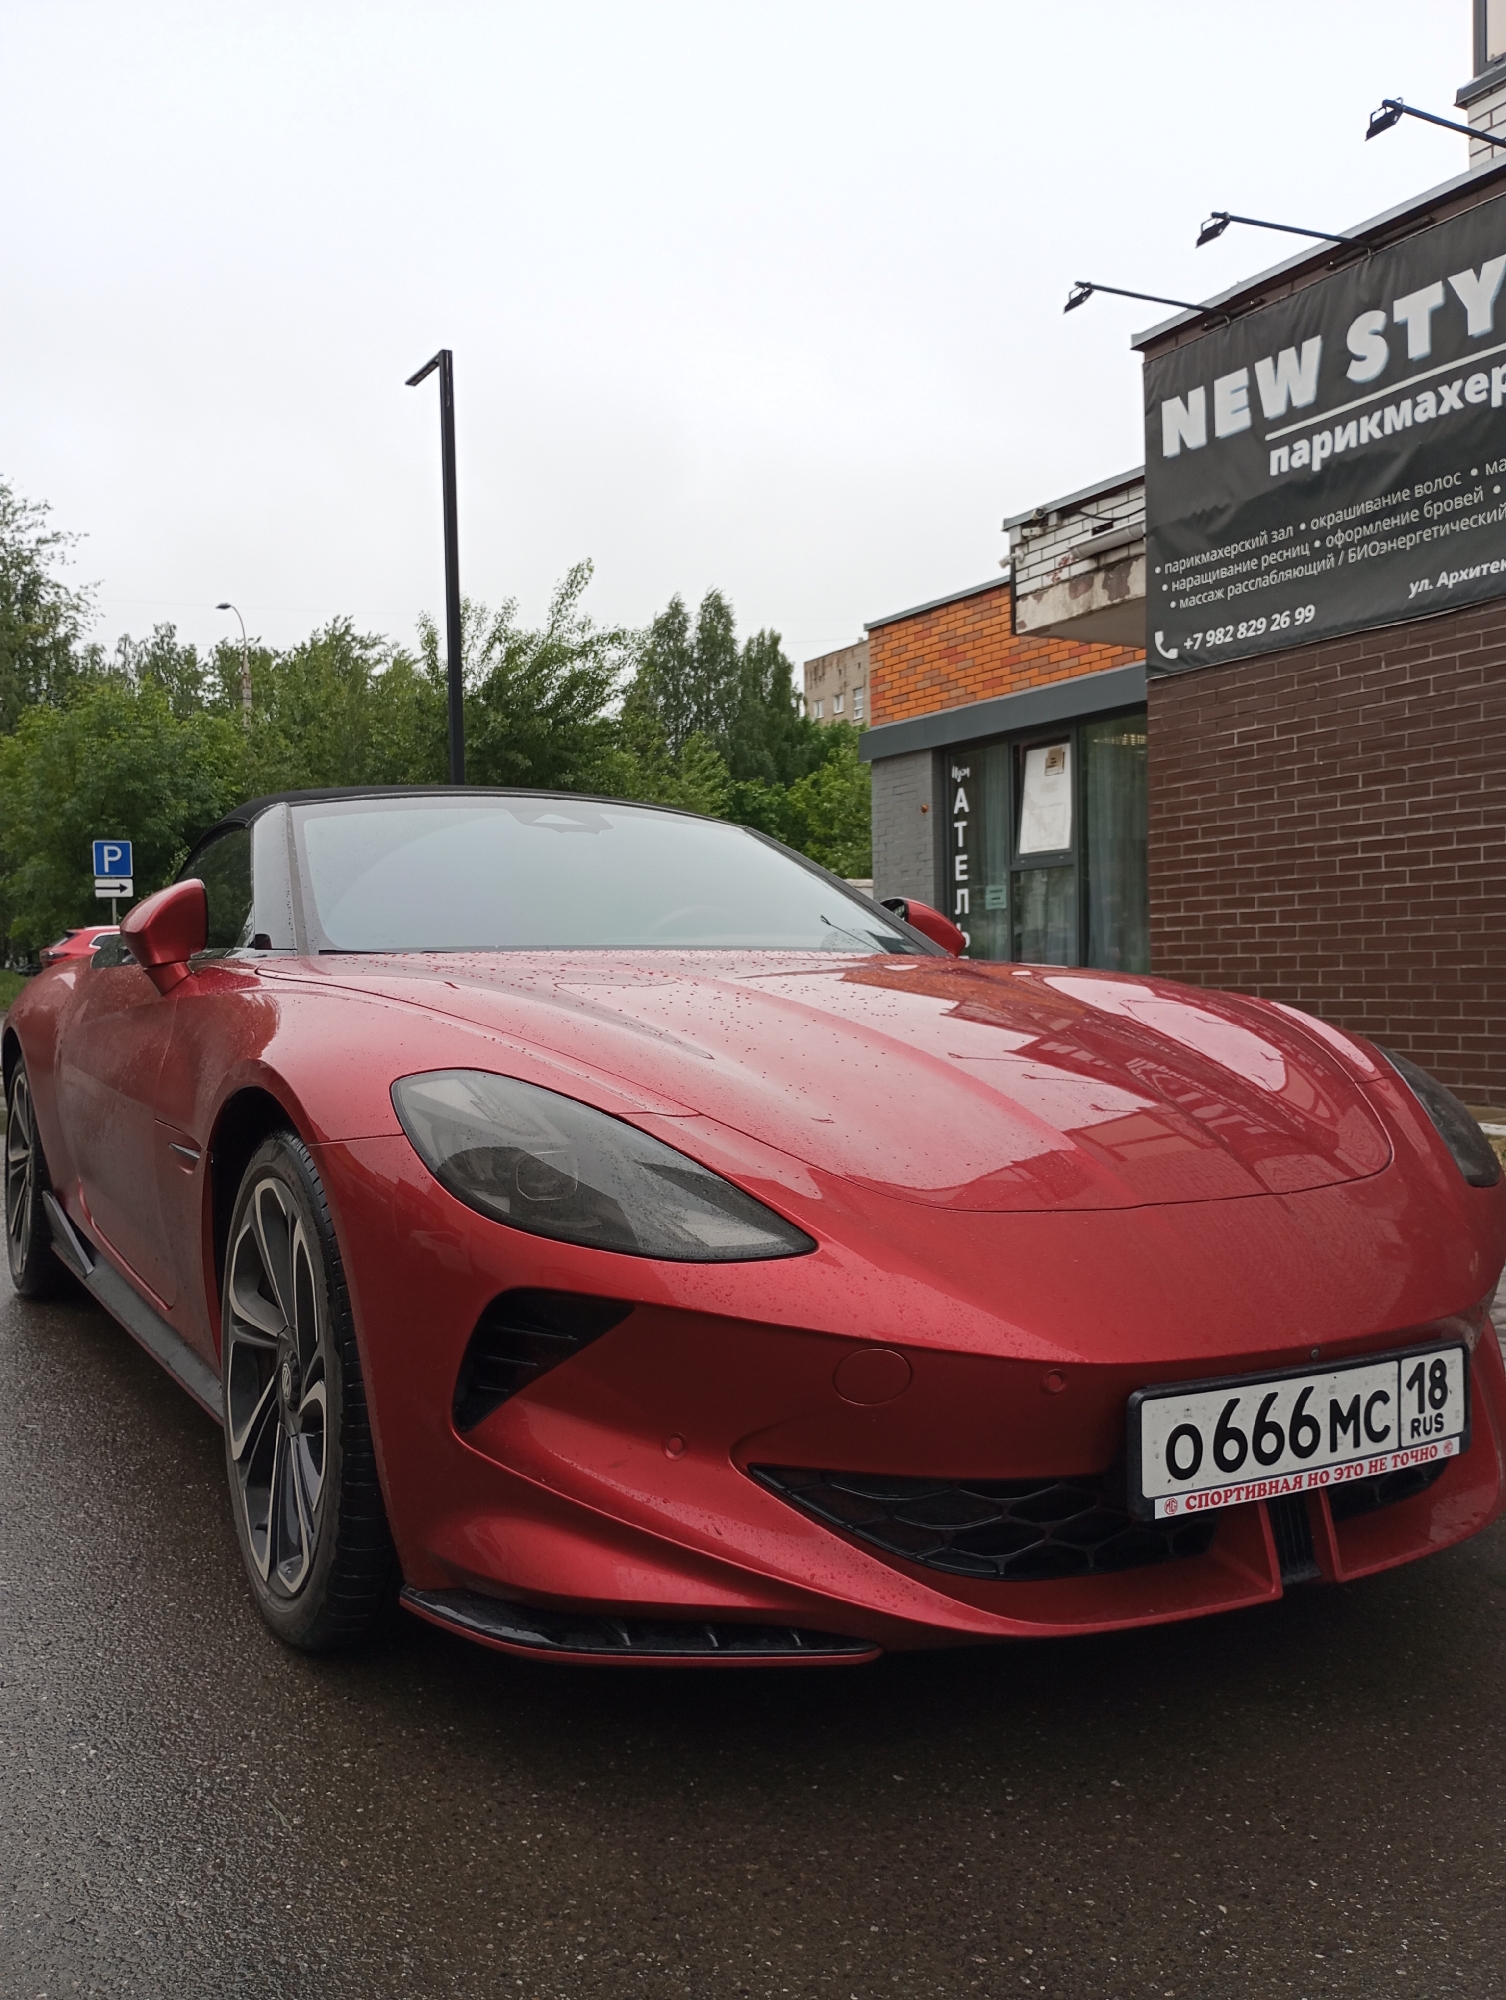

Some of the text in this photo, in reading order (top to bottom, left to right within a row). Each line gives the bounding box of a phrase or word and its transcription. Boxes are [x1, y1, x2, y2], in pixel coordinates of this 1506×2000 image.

[1161, 254, 1506, 458] NEW STY
[1269, 362, 1506, 476] парикмахер
[1164, 530, 1269, 575] парикмахерский
[1271, 525, 1294, 544] зал
[1310, 488, 1411, 531] окрашивание
[1414, 471, 1462, 499] волос
[1171, 485, 1484, 592] наращивание ресниц оформление бровей
[1179, 587, 1225, 609] массаж
[1227, 552, 1335, 600] расслабляющий
[1348, 502, 1506, 564] БИОэнергетический
[1183, 603, 1316, 651] +7 982 829 26 99
[1408, 578, 1433, 600] ул.
[103, 845, 122, 873] P
[953, 787, 970, 959] АТЕЛ
[1165, 1358, 1449, 1481] О666МС 18
[1410, 1413, 1445, 1439] RUS
[1185, 1475, 1303, 1511] СПОРТИВНАЯ
[1307, 1469, 1330, 1488] НО
[1334, 1462, 1364, 1483] ЭТО
[1368, 1457, 1387, 1475] НЕ
[1391, 1445, 1438, 1469] ТОЧНО
